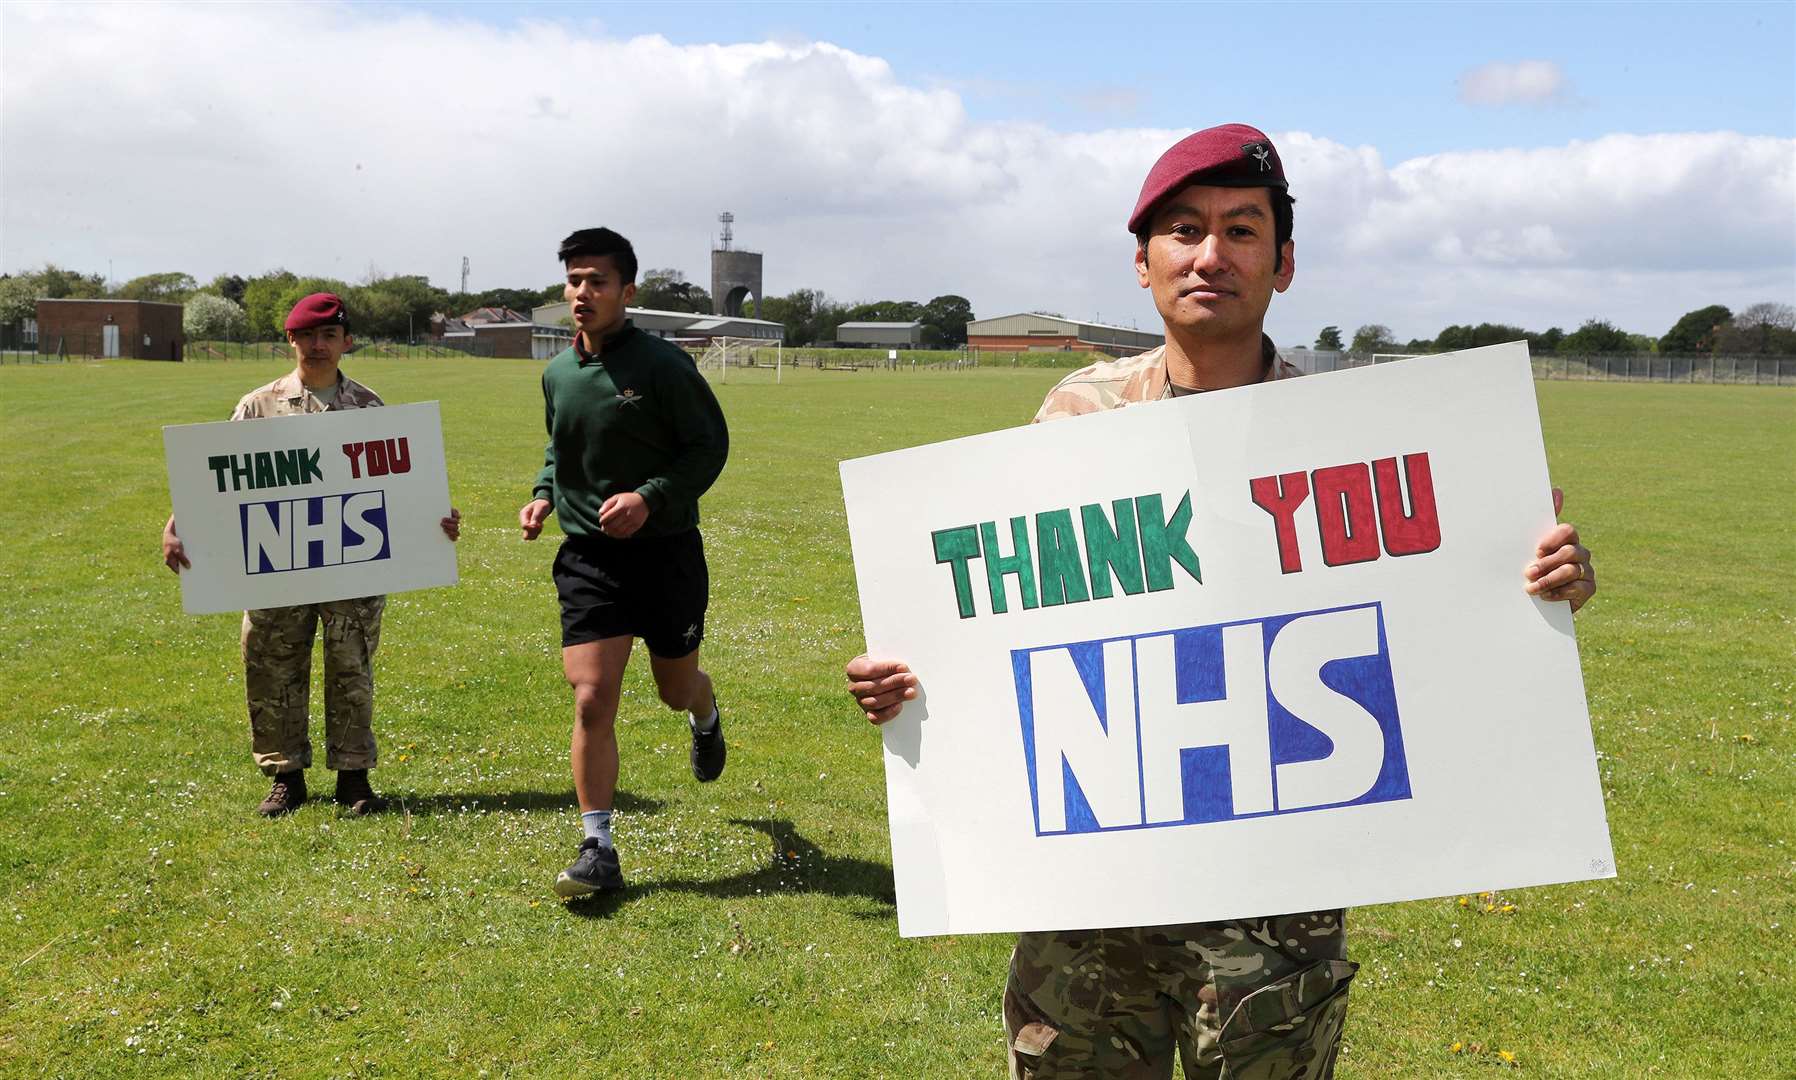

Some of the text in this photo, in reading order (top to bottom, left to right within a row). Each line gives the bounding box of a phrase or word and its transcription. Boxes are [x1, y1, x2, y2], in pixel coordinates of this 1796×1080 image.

[208, 437, 411, 492] THANK YOU
[246, 491, 386, 574] NHS
[931, 452, 1441, 619] THANK YOU
[1027, 606, 1388, 833] NHS
